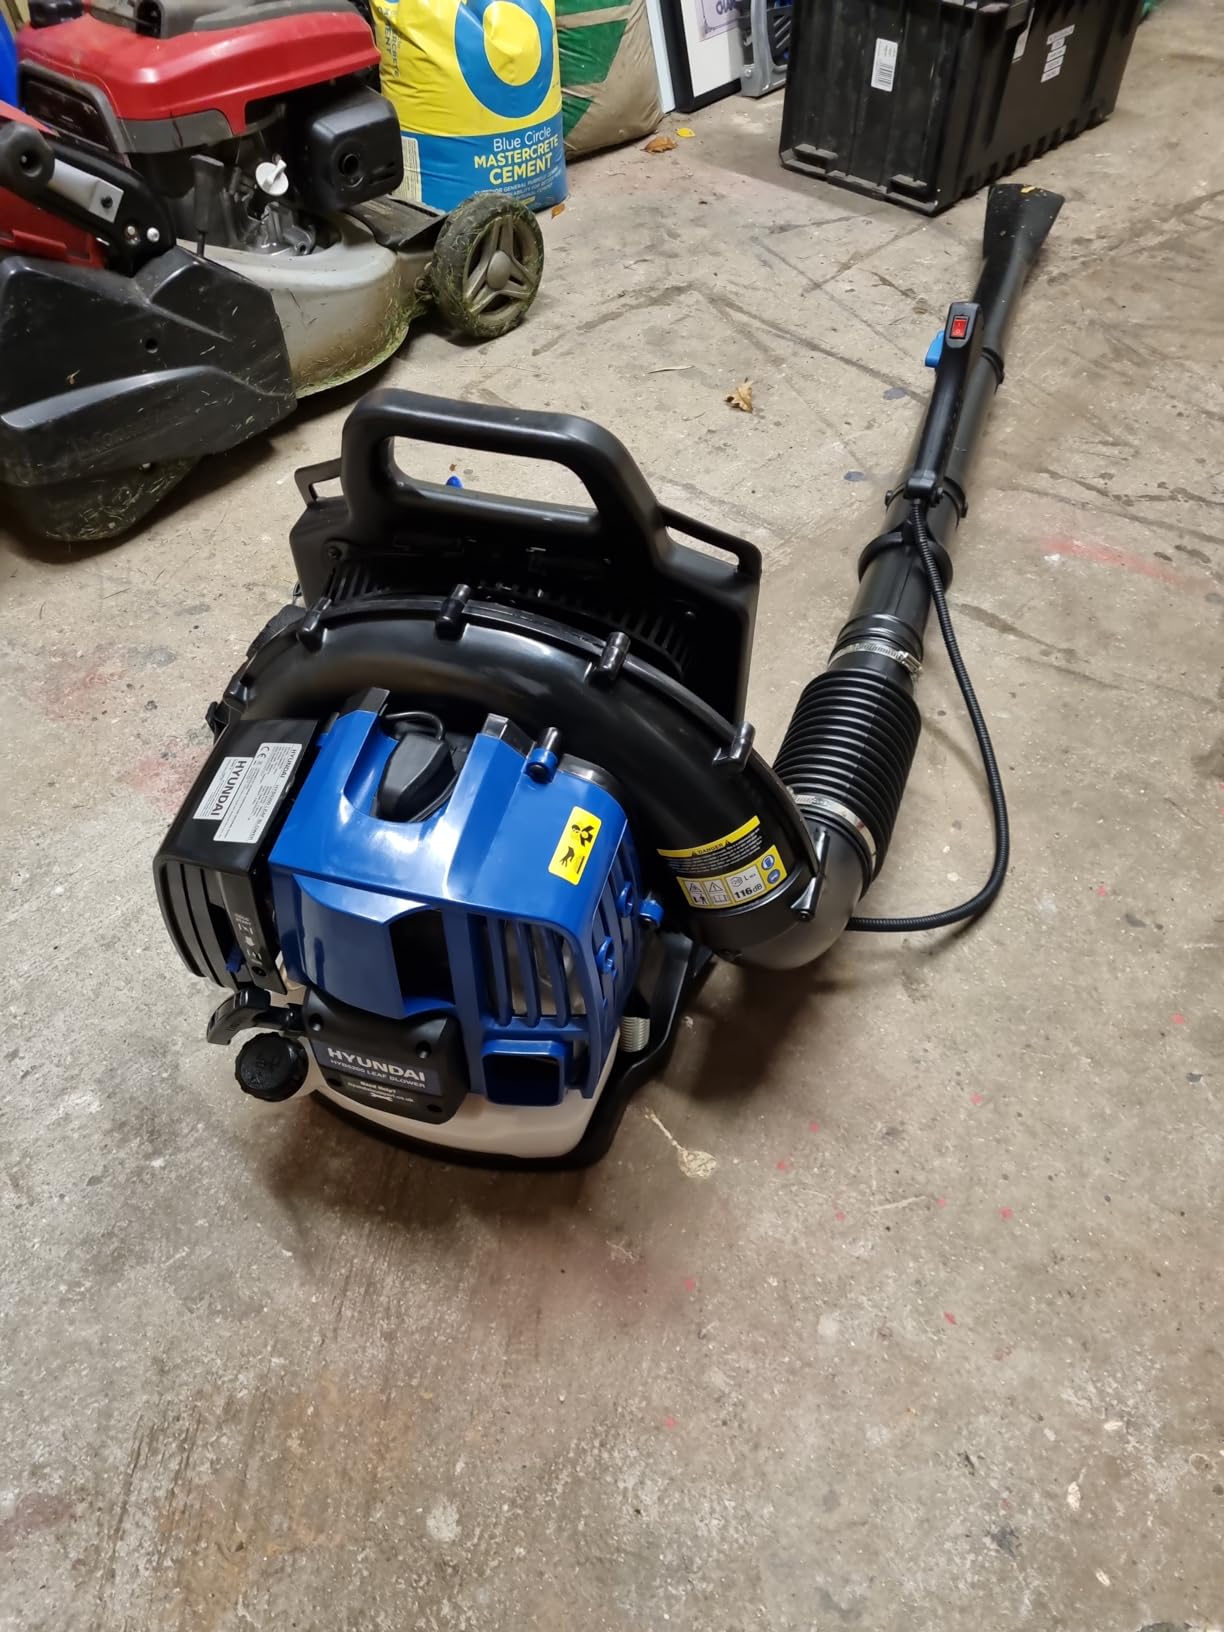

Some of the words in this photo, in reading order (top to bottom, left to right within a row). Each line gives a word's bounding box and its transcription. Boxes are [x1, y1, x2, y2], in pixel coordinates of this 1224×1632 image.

[473, 134, 559, 169] MASTERCRETE
[493, 137, 521, 152] Blue
[524, 126, 552, 145] Circle
[489, 152, 553, 185] CEMENT
[279, 749, 297, 778] HYUNDAI
[210, 760, 247, 816] HYUNDAI
[697, 842, 724, 855] DANGER
[734, 886, 753, 899] 116
[752, 883, 763, 893] dB
[327, 1047, 426, 1082] HYUNDAI
[366, 1069, 387, 1079] LEAF
[388, 1075, 426, 1089] BLOWER
